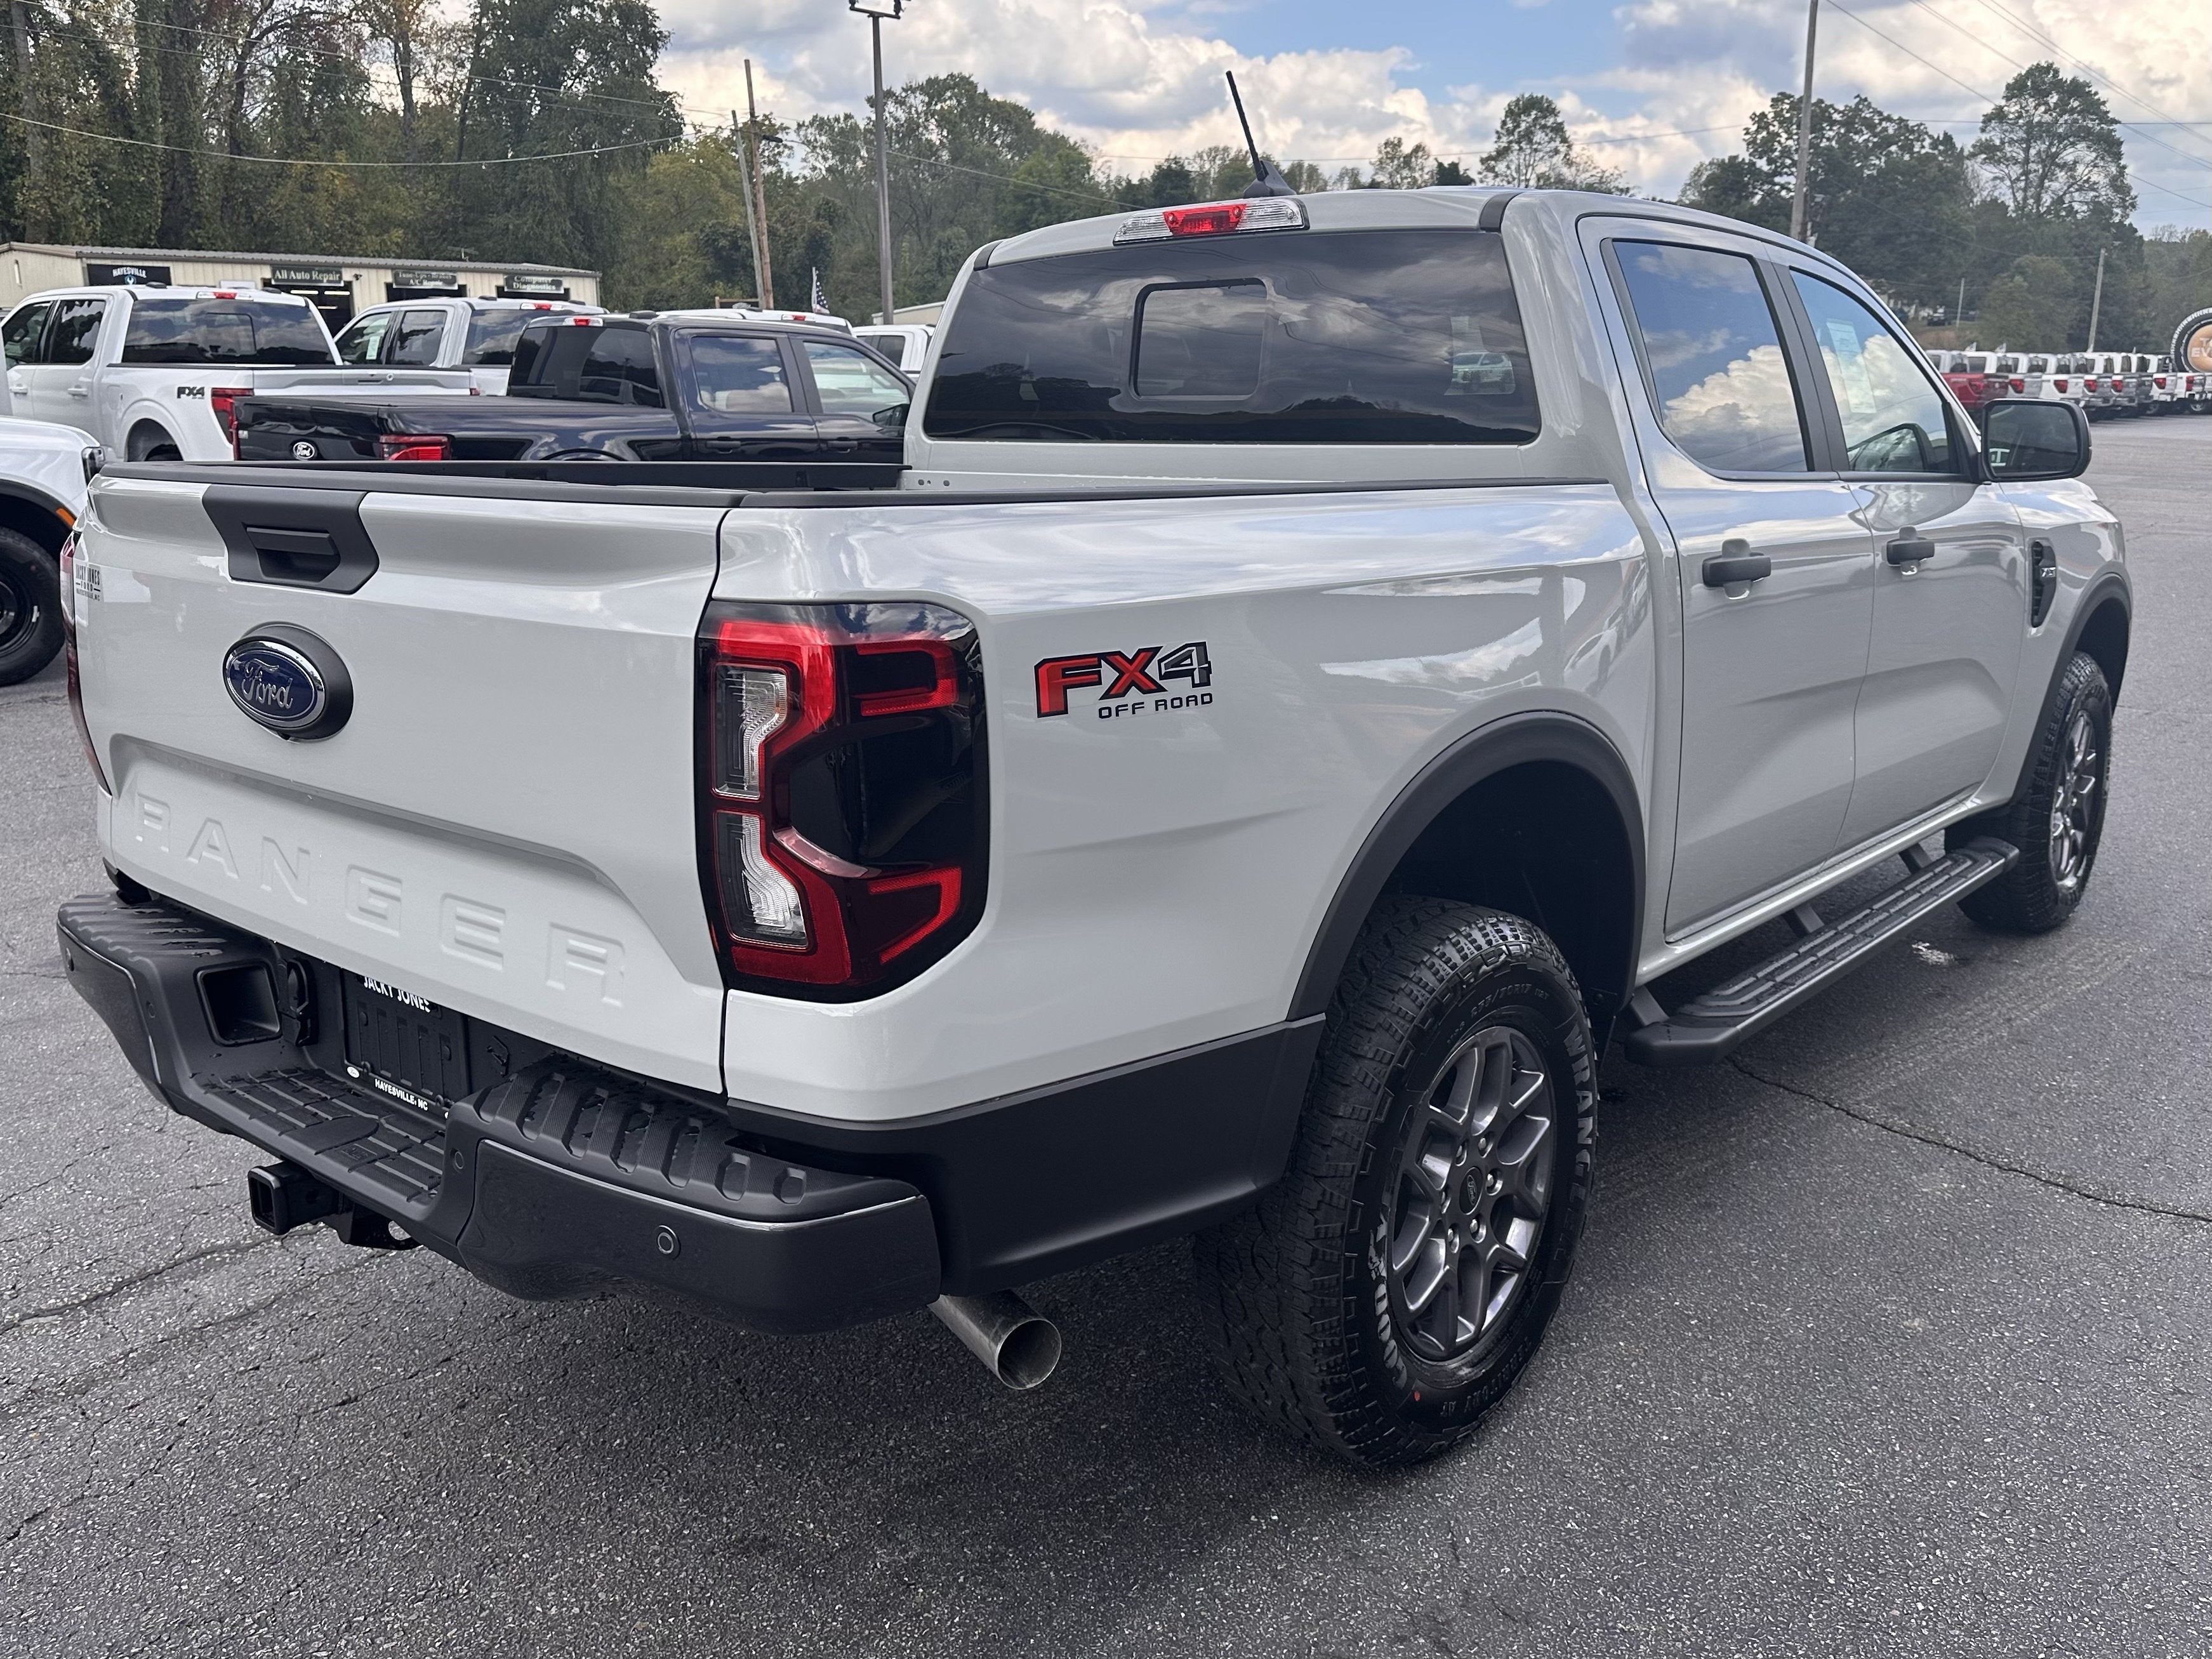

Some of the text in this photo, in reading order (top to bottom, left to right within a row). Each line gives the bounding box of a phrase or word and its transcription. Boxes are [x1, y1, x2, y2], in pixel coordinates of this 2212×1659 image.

[274, 269, 341, 283] All Auto Repair
[177, 387, 204, 399] FX4
[296, 444, 310, 456] Ford
[241, 658, 293, 710] Ford
[1034, 641, 1212, 718] FX4
[1098, 692, 1214, 720] OFF ROAD
[136, 791, 627, 1007] RANGER
[364, 976, 431, 1013] JACKY JONES
[374, 1078, 428, 1111] HAYESVILLE, NC
